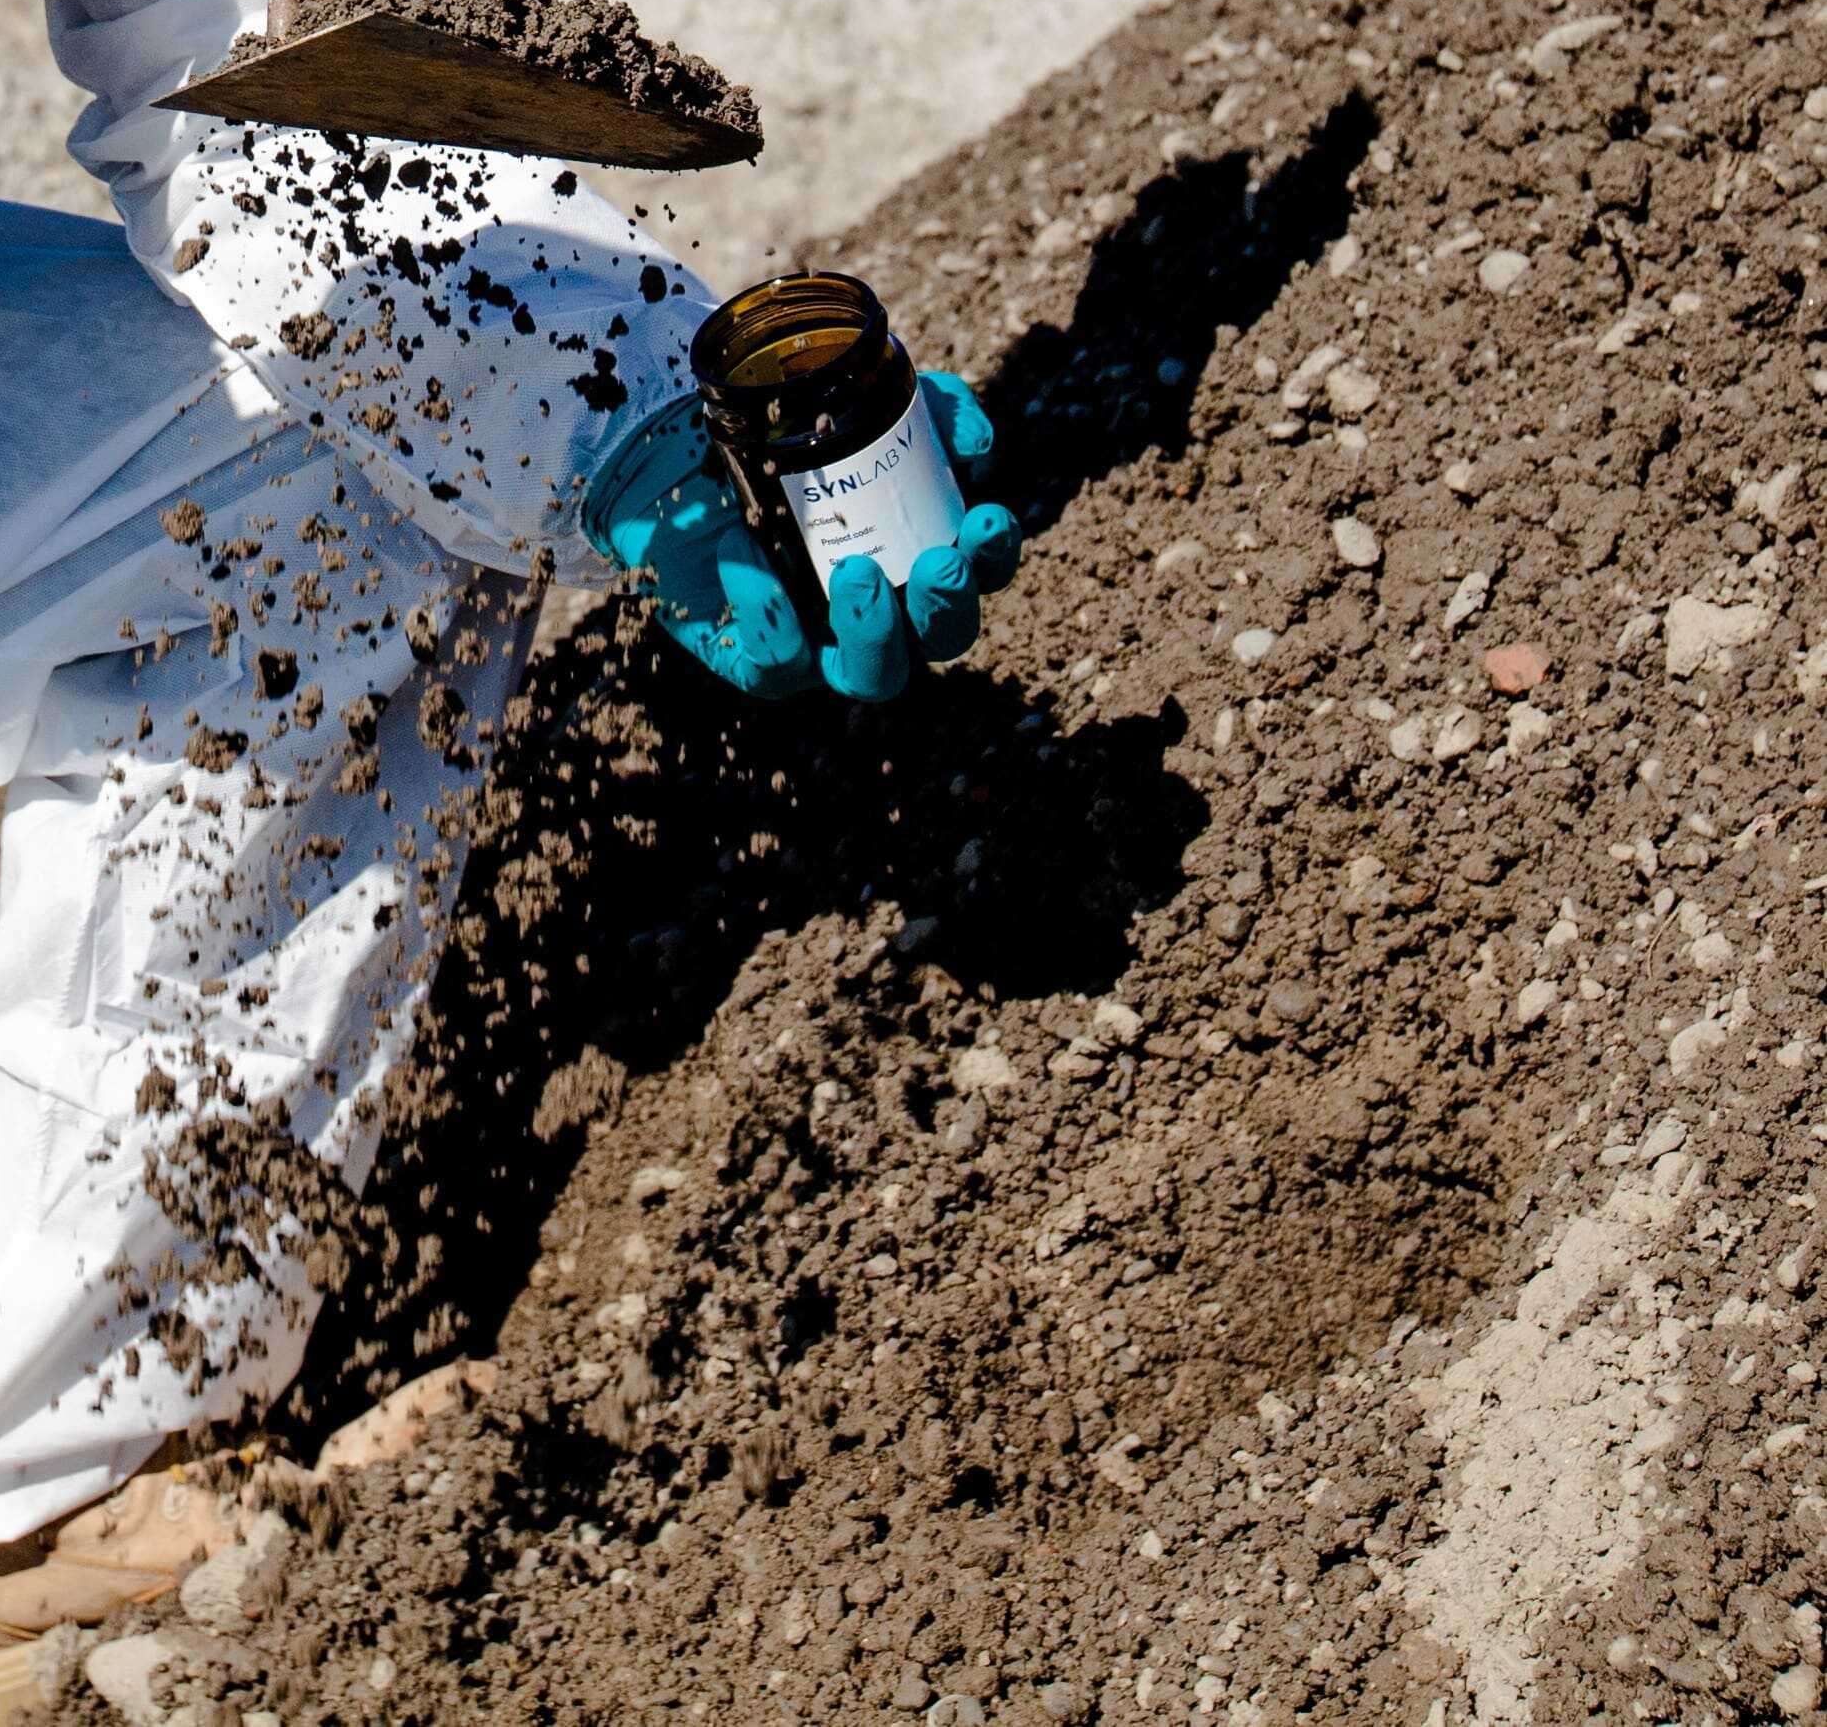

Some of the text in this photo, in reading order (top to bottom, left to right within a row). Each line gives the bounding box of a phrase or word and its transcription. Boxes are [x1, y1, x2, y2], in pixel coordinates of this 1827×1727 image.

[803, 448, 900, 503] SYNLAB
[821, 524, 878, 546] Project code:
